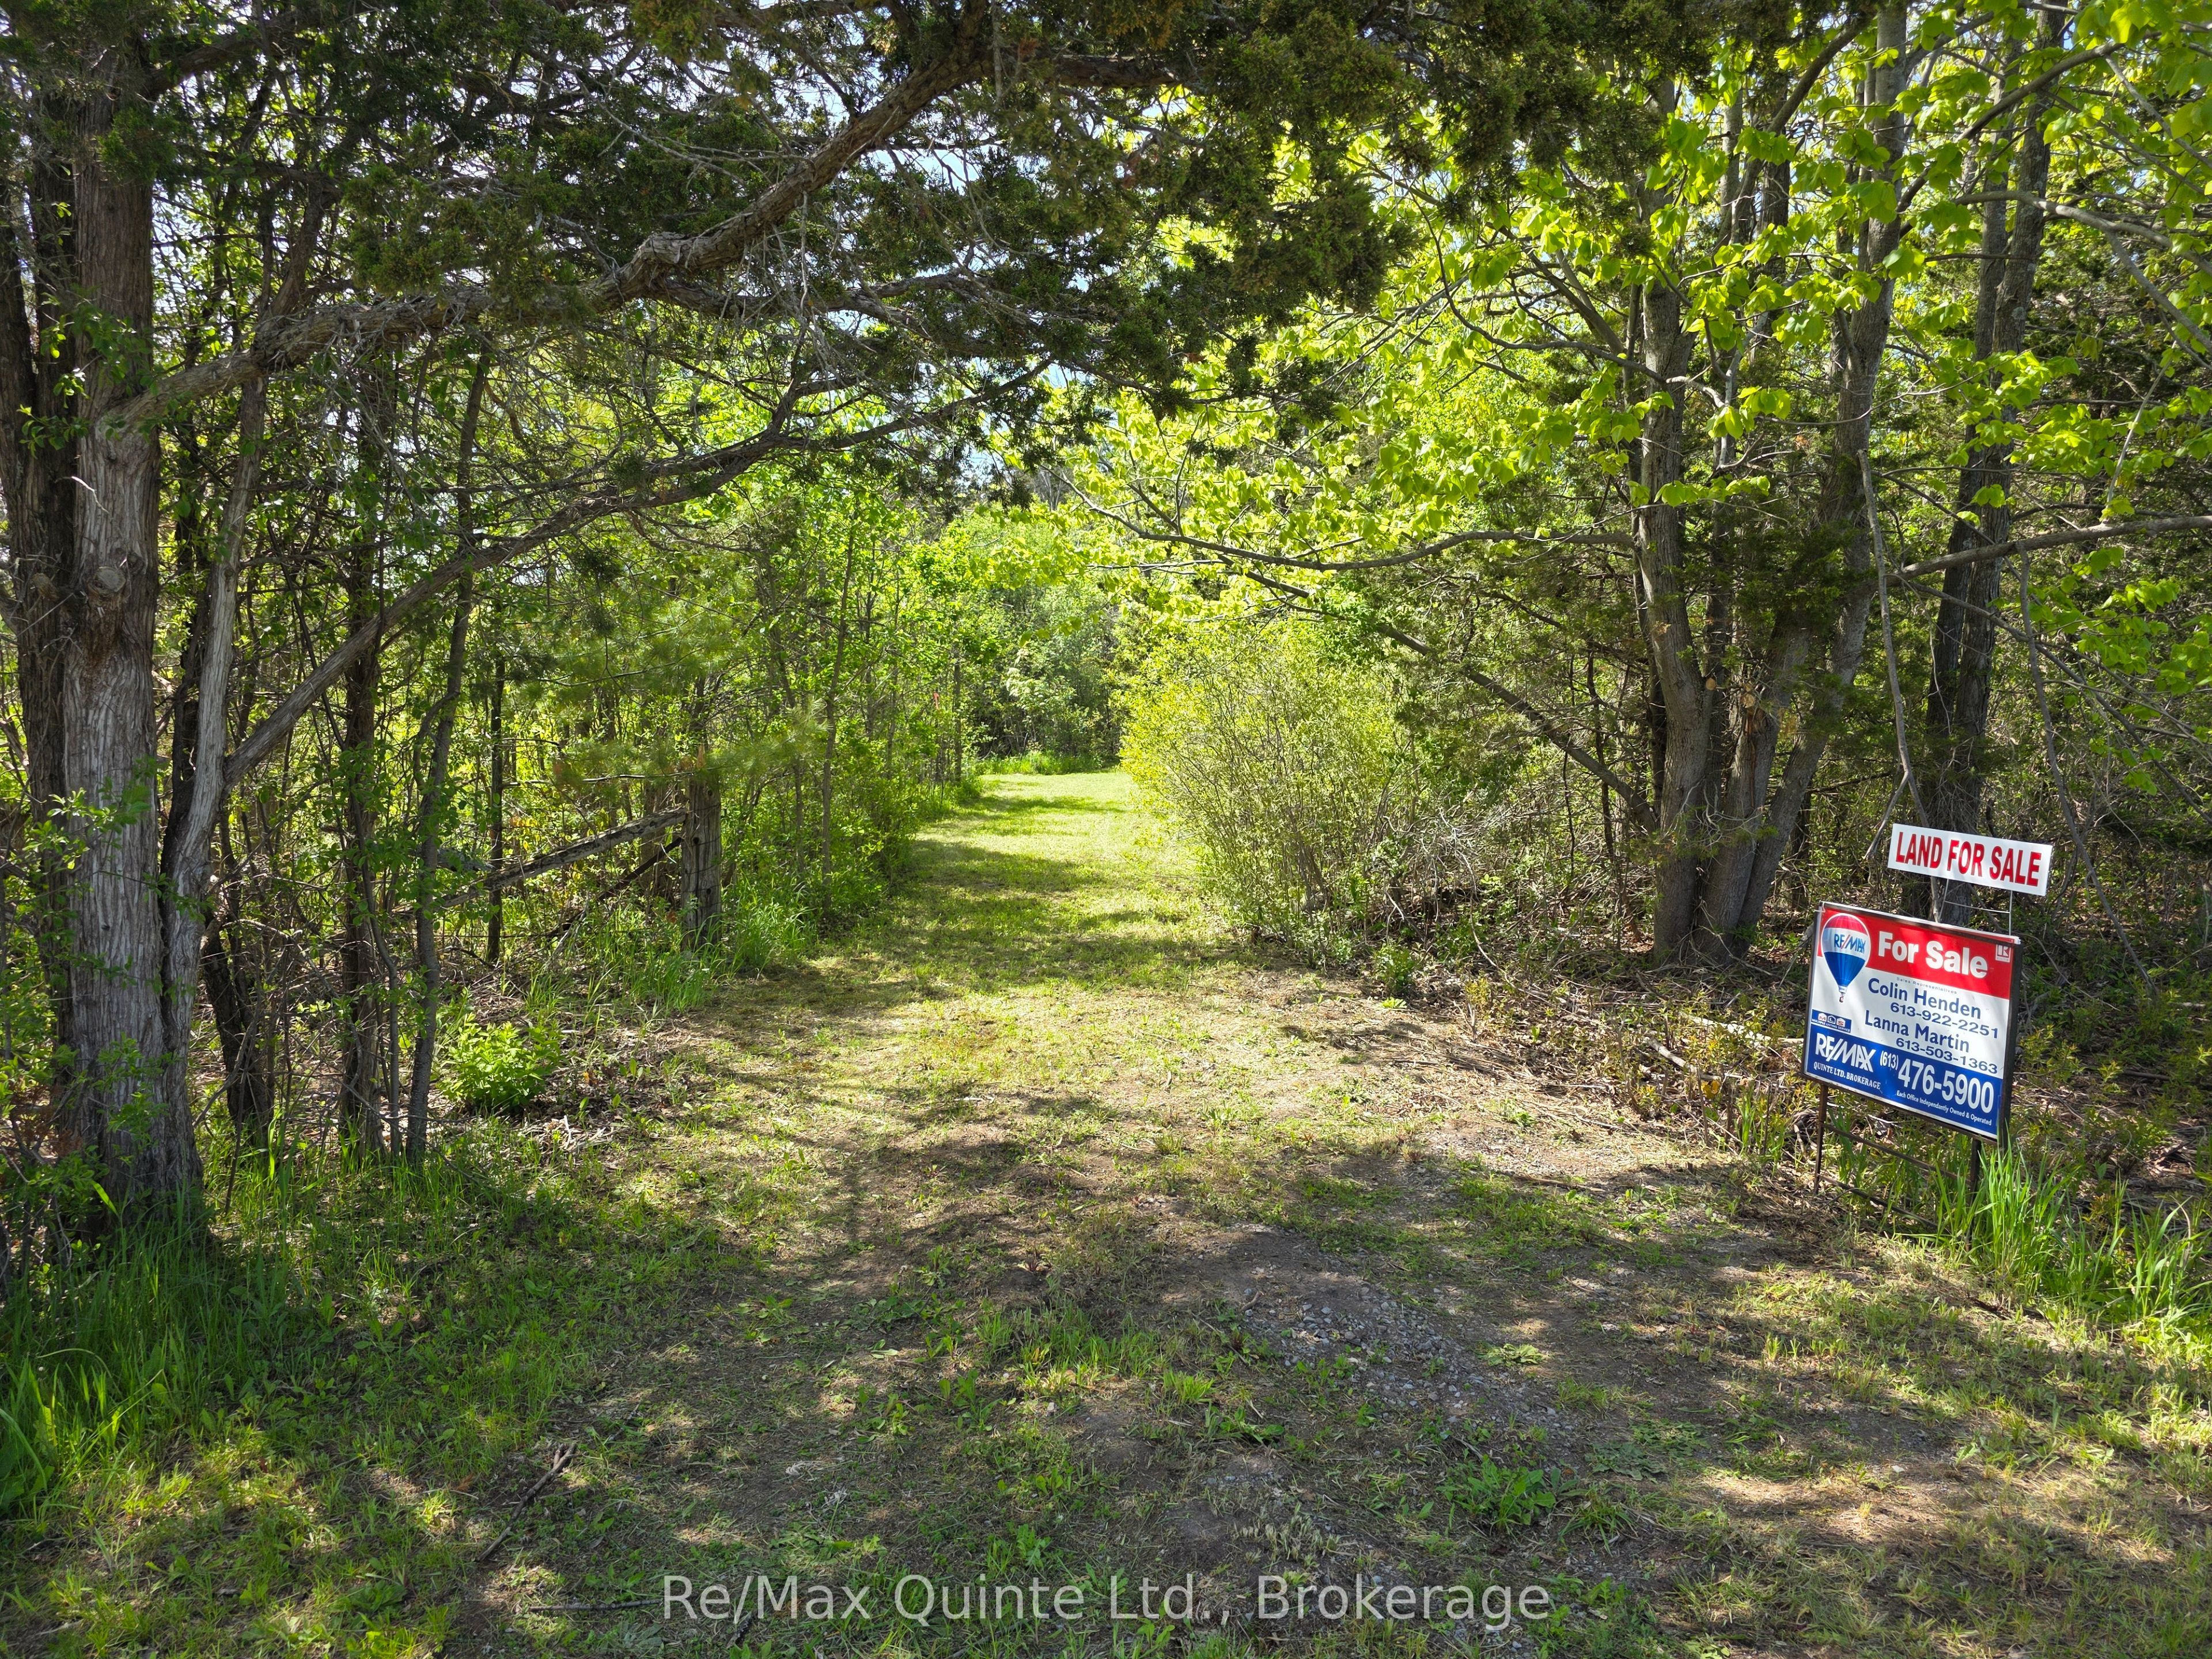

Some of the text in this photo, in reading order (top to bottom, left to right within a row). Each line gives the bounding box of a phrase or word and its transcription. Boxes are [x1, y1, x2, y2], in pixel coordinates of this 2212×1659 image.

[1896, 831, 2041, 887] LAND FOR SALE
[1834, 933, 1866, 954] RE/MAX
[1878, 931, 1987, 978] For Sale
[1868, 978, 1981, 1019] Colin Henden
[1865, 1010, 1969, 1052] Lanna Martin
[1890, 1002, 1998, 1039] 613-922-2251
[1815, 1032, 1877, 1072] RE/MAX
[1896, 1037, 1998, 1074] 613-503-1363
[1813, 1061, 1881, 1090] QUINTE LTD. BROKERAGE
[1880, 1050, 1994, 1113] (613) 476-5900
[1896, 1090, 1906, 1099] Each
[1907, 1093, 1919, 1103] Office
[1950, 1107, 1965, 1118] Owned
[1970, 1113, 1992, 1126] Operated
